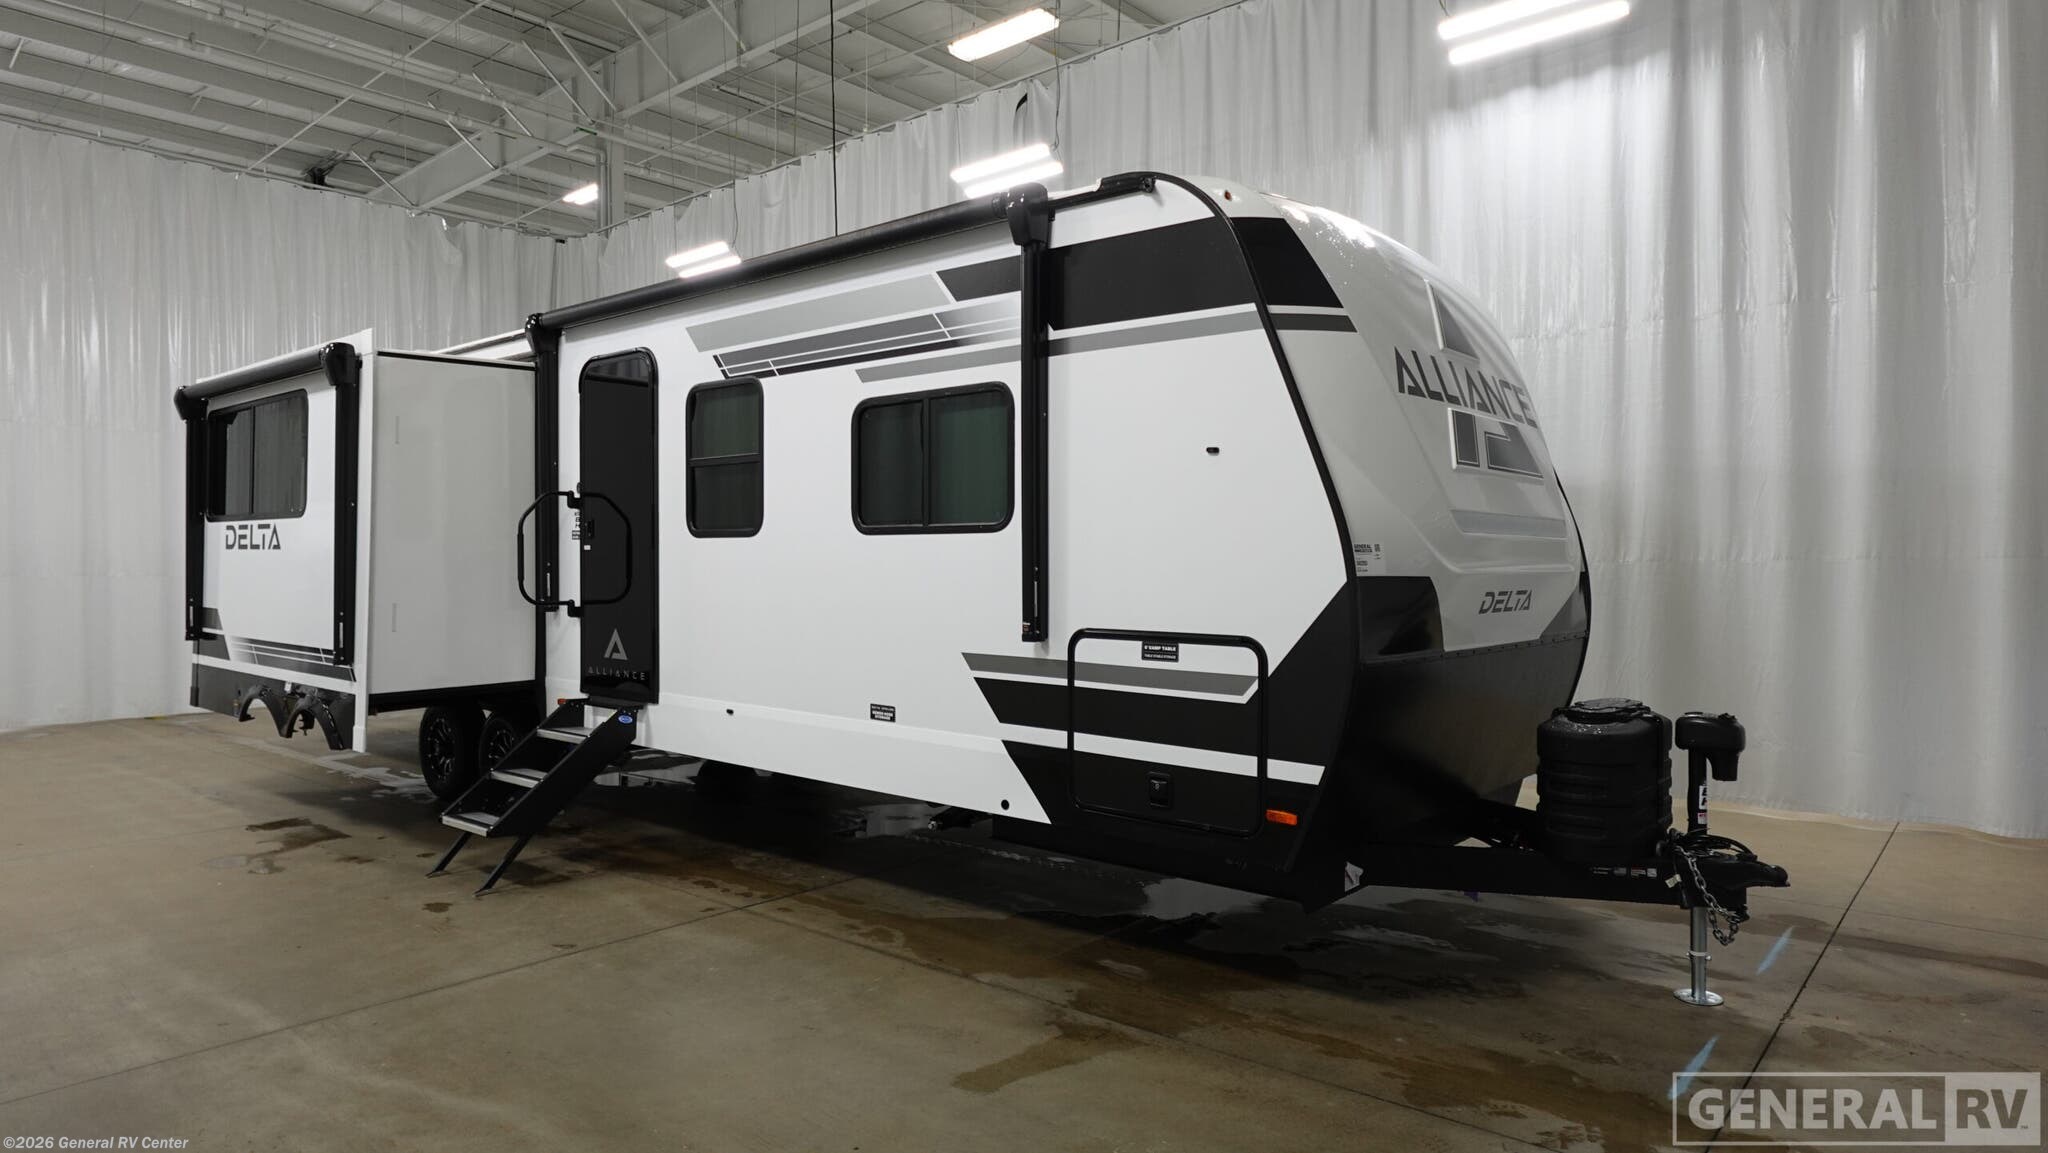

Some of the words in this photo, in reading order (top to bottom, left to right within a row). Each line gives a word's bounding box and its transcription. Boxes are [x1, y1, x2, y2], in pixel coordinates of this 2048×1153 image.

[1394, 346, 1538, 428] ALLIANCE
[225, 523, 281, 550] DELTA
[1478, 590, 1532, 614] DELTA
[588, 666, 646, 680] ALLIANCE
